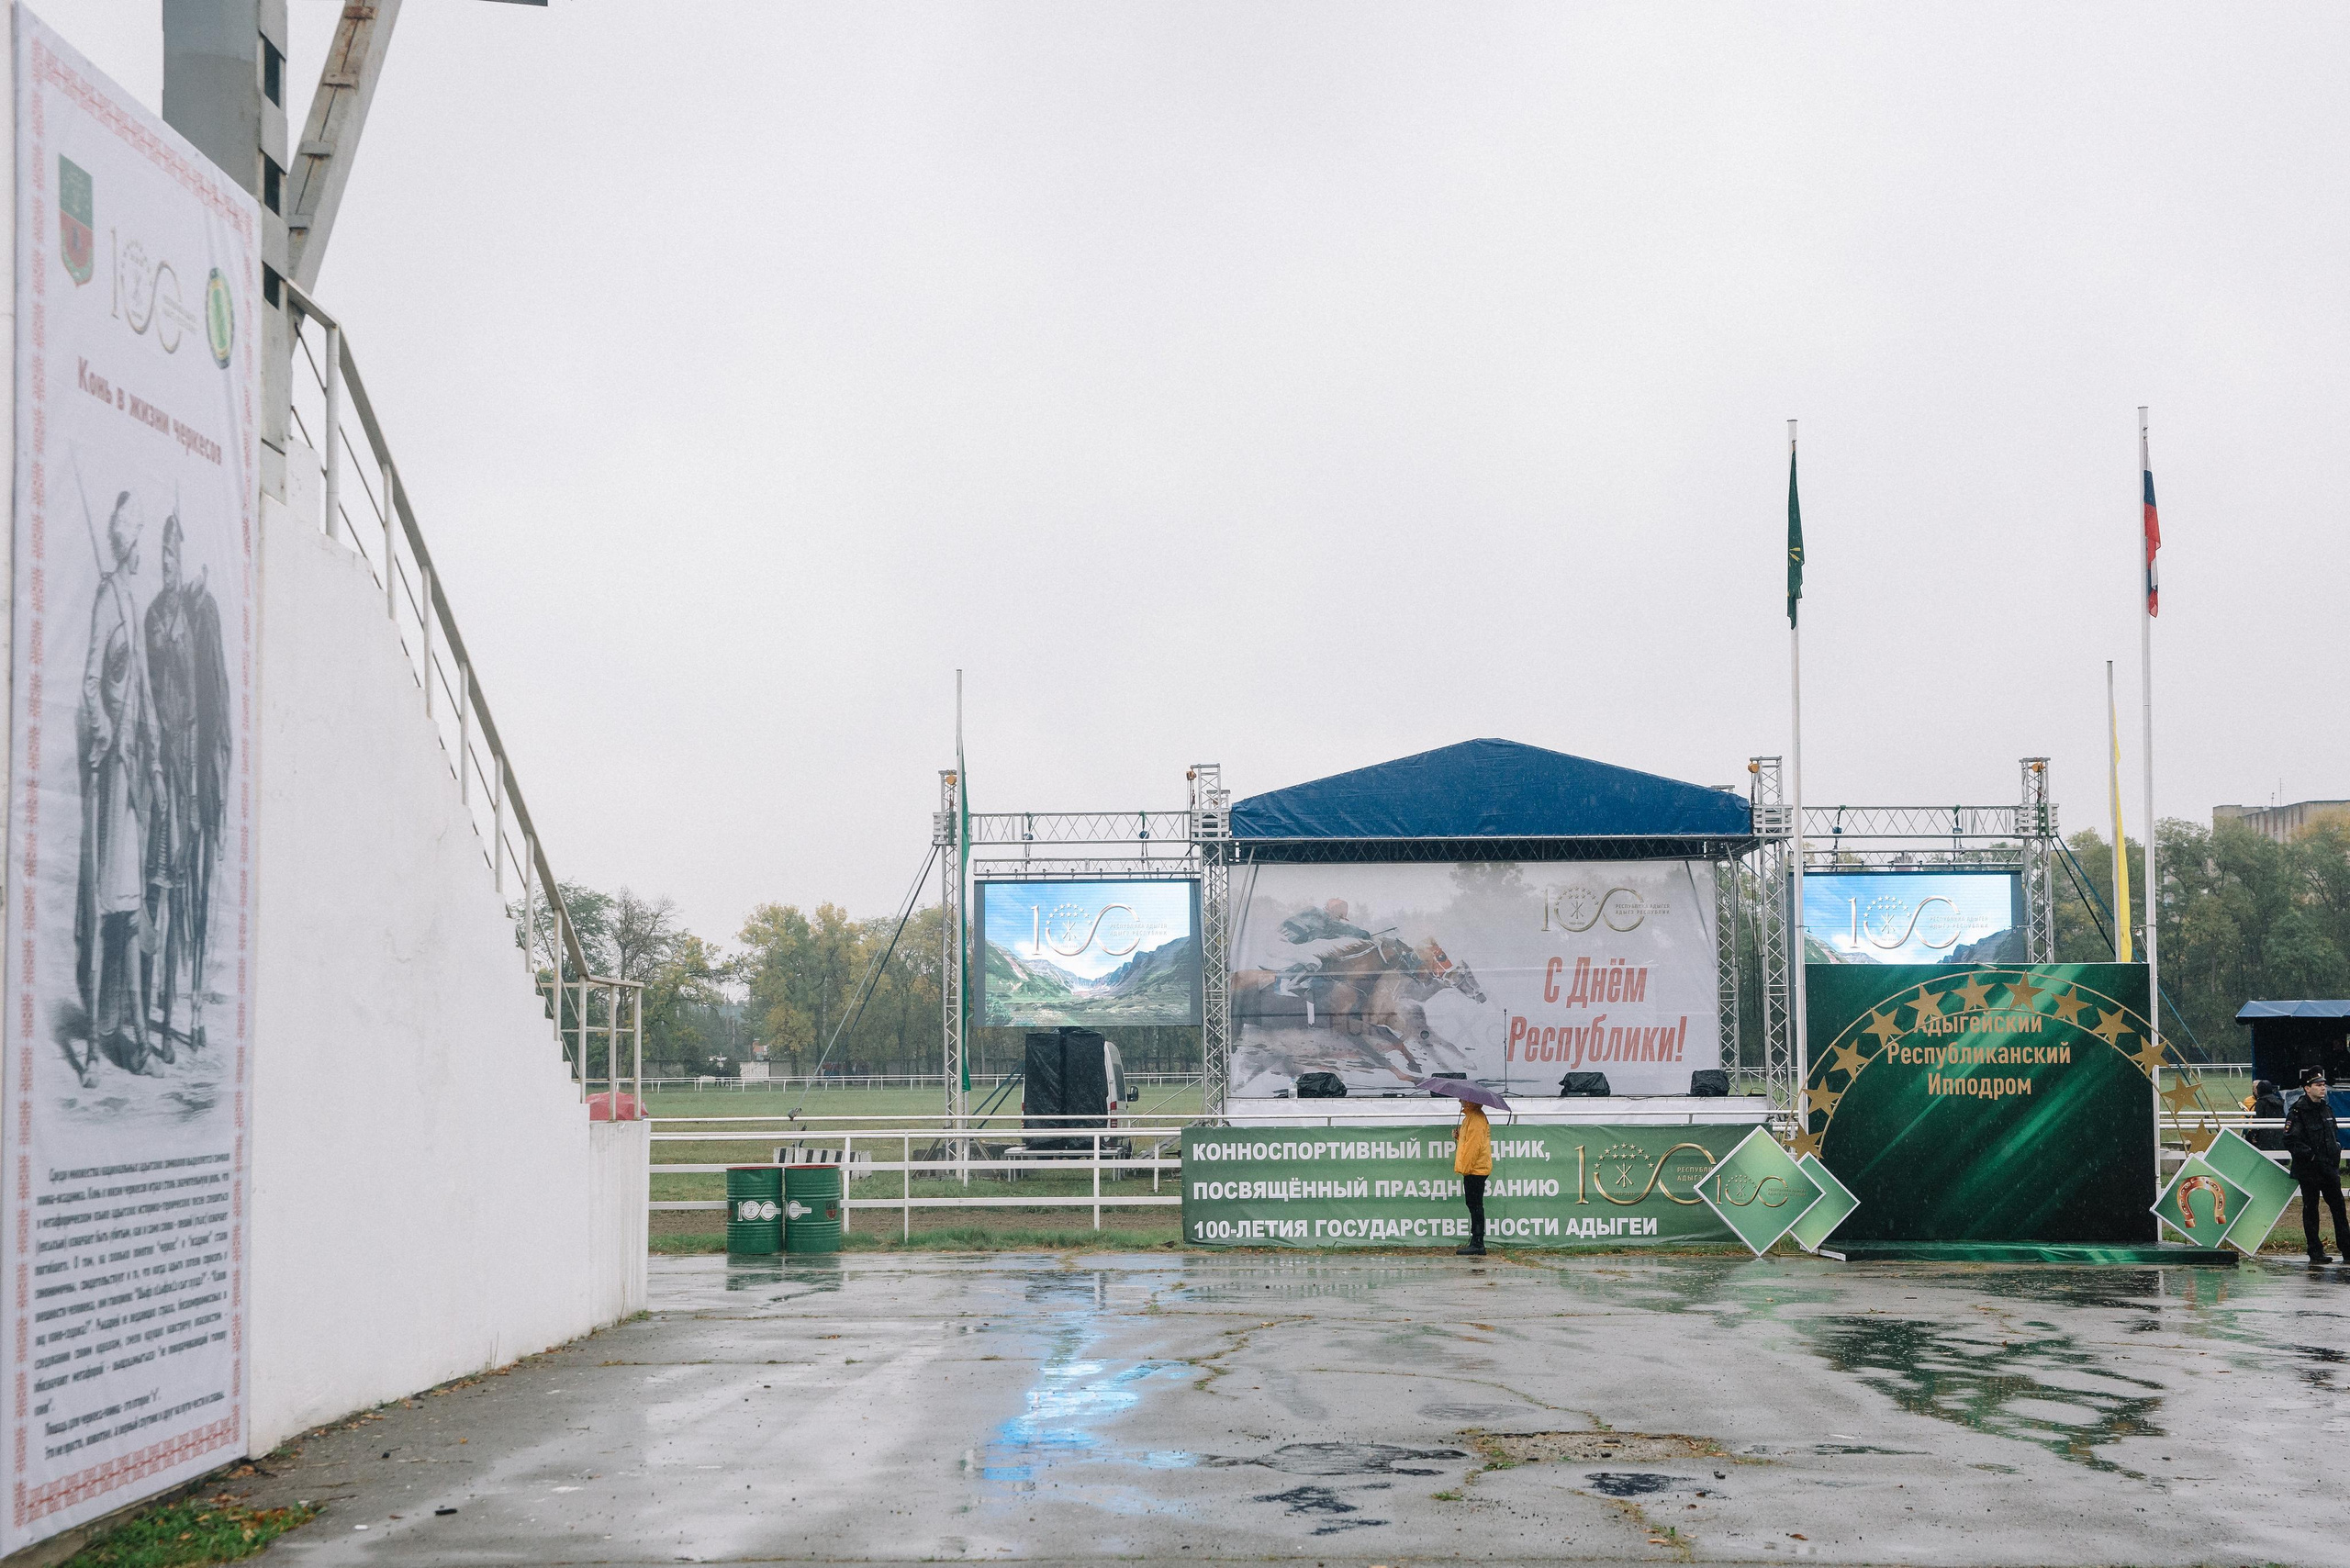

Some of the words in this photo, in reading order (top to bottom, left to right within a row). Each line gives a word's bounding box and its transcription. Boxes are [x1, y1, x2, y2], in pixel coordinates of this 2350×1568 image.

[77, 356, 113, 405] Конь
[117, 386, 125, 411] в
[129, 393, 170, 437] жизни
[173, 418, 222, 467] черкесов
[1543, 957, 1563, 1003] С
[1566, 957, 1648, 1009] Днём
[1506, 1014, 1688, 1070] Республики!
[1887, 1041, 2071, 1070] Республиканский
[1928, 1072, 2032, 1101] Ипподром
[1192, 1137, 1422, 1160] КОННОСПОРТИВНЫЙ
[1428, 1139, 1550, 1162] ПРДНИК,
[1193, 1177, 1369, 1203] ПОСВЯЩЁННЫЙ
[1375, 1178, 1560, 1201] ПРАЗДНВАНИЮ
[1194, 1219, 1308, 1239] 100-ЛЕТИЯ
[1315, 1217, 1560, 1240] ГОСУДАРСТВЕНОСТИ
[1565, 1217, 1658, 1239] АДЫГЕИ
